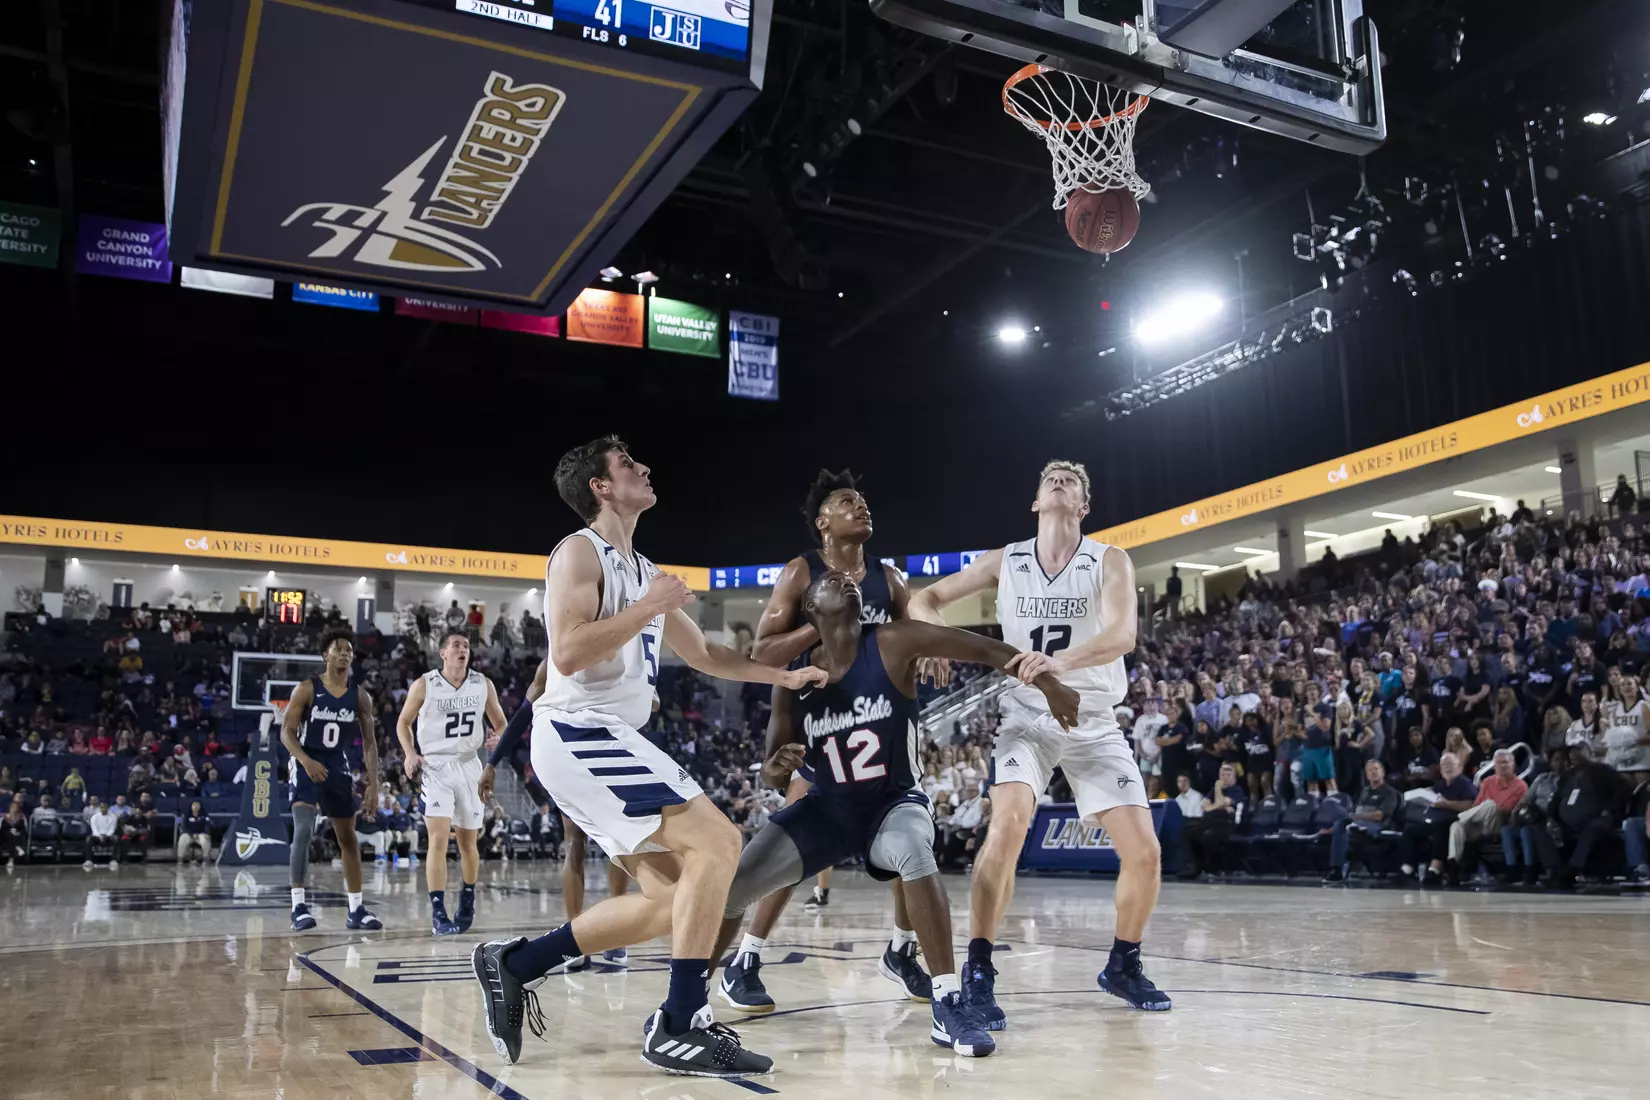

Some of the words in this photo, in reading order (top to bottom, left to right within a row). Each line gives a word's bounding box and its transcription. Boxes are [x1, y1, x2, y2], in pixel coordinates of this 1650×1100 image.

[470, 1, 500, 16] 2ND
[506, 4, 541, 25] HALF
[594, 0, 622, 28] 41
[582, 26, 609, 43] FLS
[618, 34, 627, 47] 6
[419, 70, 566, 229] LANCERS
[102, 228, 150, 243] GRAND
[0, 239, 47, 254] ERSITY
[97, 240, 153, 256] CANYON
[86, 251, 162, 270] UNIVERSITY
[653, 313, 682, 326] UTAH
[682, 317, 718, 330] VALLEY
[739, 316, 770, 332] CBI
[657, 325, 714, 341] UNIVERSITY
[1545, 387, 1603, 419] AYRES
[1350, 452, 1393, 477] AYRES
[1398, 432, 1458, 460] HOTELS
[1236, 485, 1283, 510] HOTELS
[54, 527, 124, 543] HOTELS
[210, 539, 262, 554] AYRES
[269, 543, 331, 558] HOTELS
[409, 552, 456, 567] AYRES
[461, 557, 519, 572] HOTELS
[922, 555, 940, 575] 41
[280, 603, 299, 624] 17
[862, 605, 886, 624] Stat
[1016, 597, 1087, 619] LANCERS
[1029, 624, 1072, 657] 12
[641, 633, 658, 686] 5
[310, 705, 338, 723] Jackson
[338, 708, 355, 723] Stat
[437, 696, 479, 711] LANCERS
[445, 711, 476, 738] 25
[804, 707, 854, 749] Jackson
[853, 694, 892, 725] State
[322, 722, 340, 748] 0
[823, 728, 886, 783] 12
[253, 760, 271, 818] CBU
